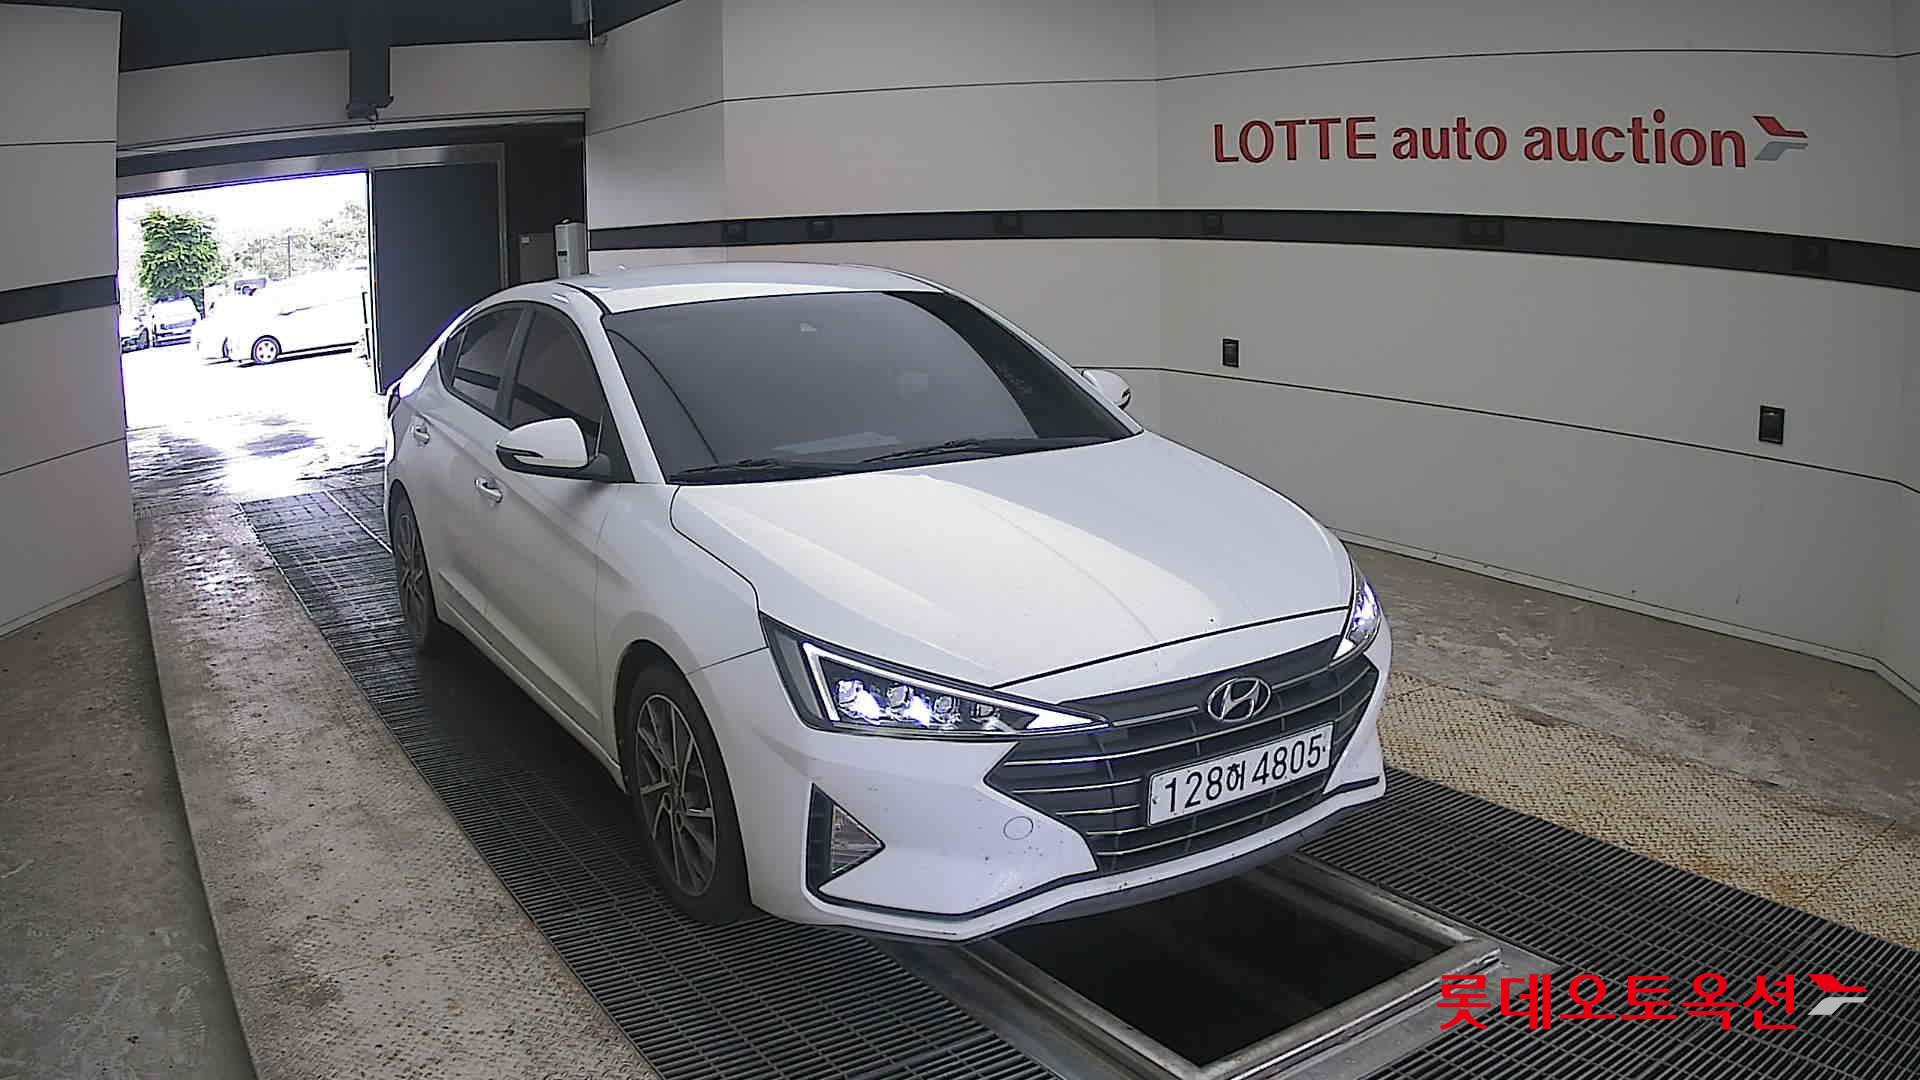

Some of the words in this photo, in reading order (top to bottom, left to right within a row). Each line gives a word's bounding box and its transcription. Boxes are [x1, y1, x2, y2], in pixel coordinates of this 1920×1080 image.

[1214, 116, 1376, 163] LOTTE
[1392, 117, 1508, 161] auto
[1523, 109, 1747, 168] auction
[1165, 760, 1246, 813] 128허
[1251, 733, 1323, 785] 4805
